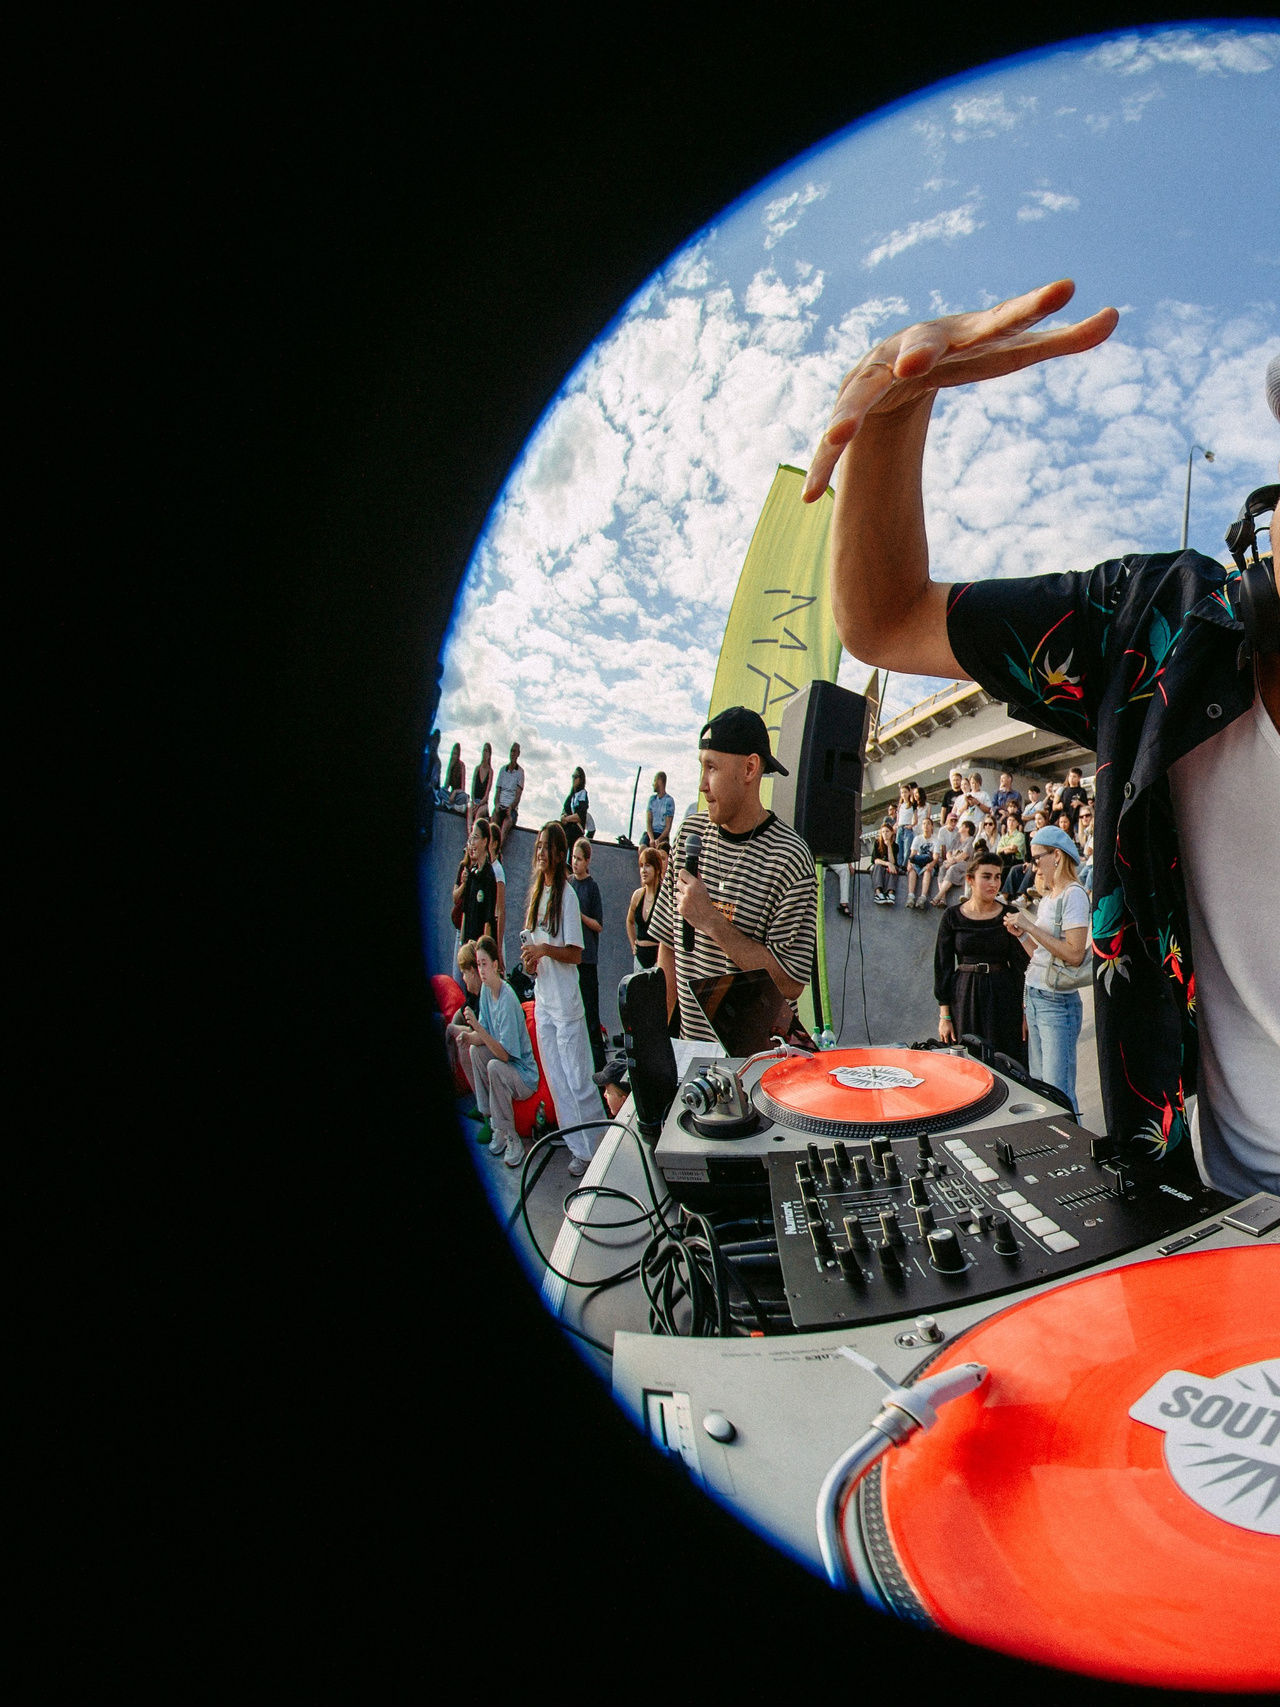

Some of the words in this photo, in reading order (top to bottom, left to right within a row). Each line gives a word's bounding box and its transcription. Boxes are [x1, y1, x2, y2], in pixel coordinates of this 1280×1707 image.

[1159, 1184, 1193, 1202] serato
[781, 1201, 798, 1235] Numark
[792, 1200, 809, 1234] SCRATCH
